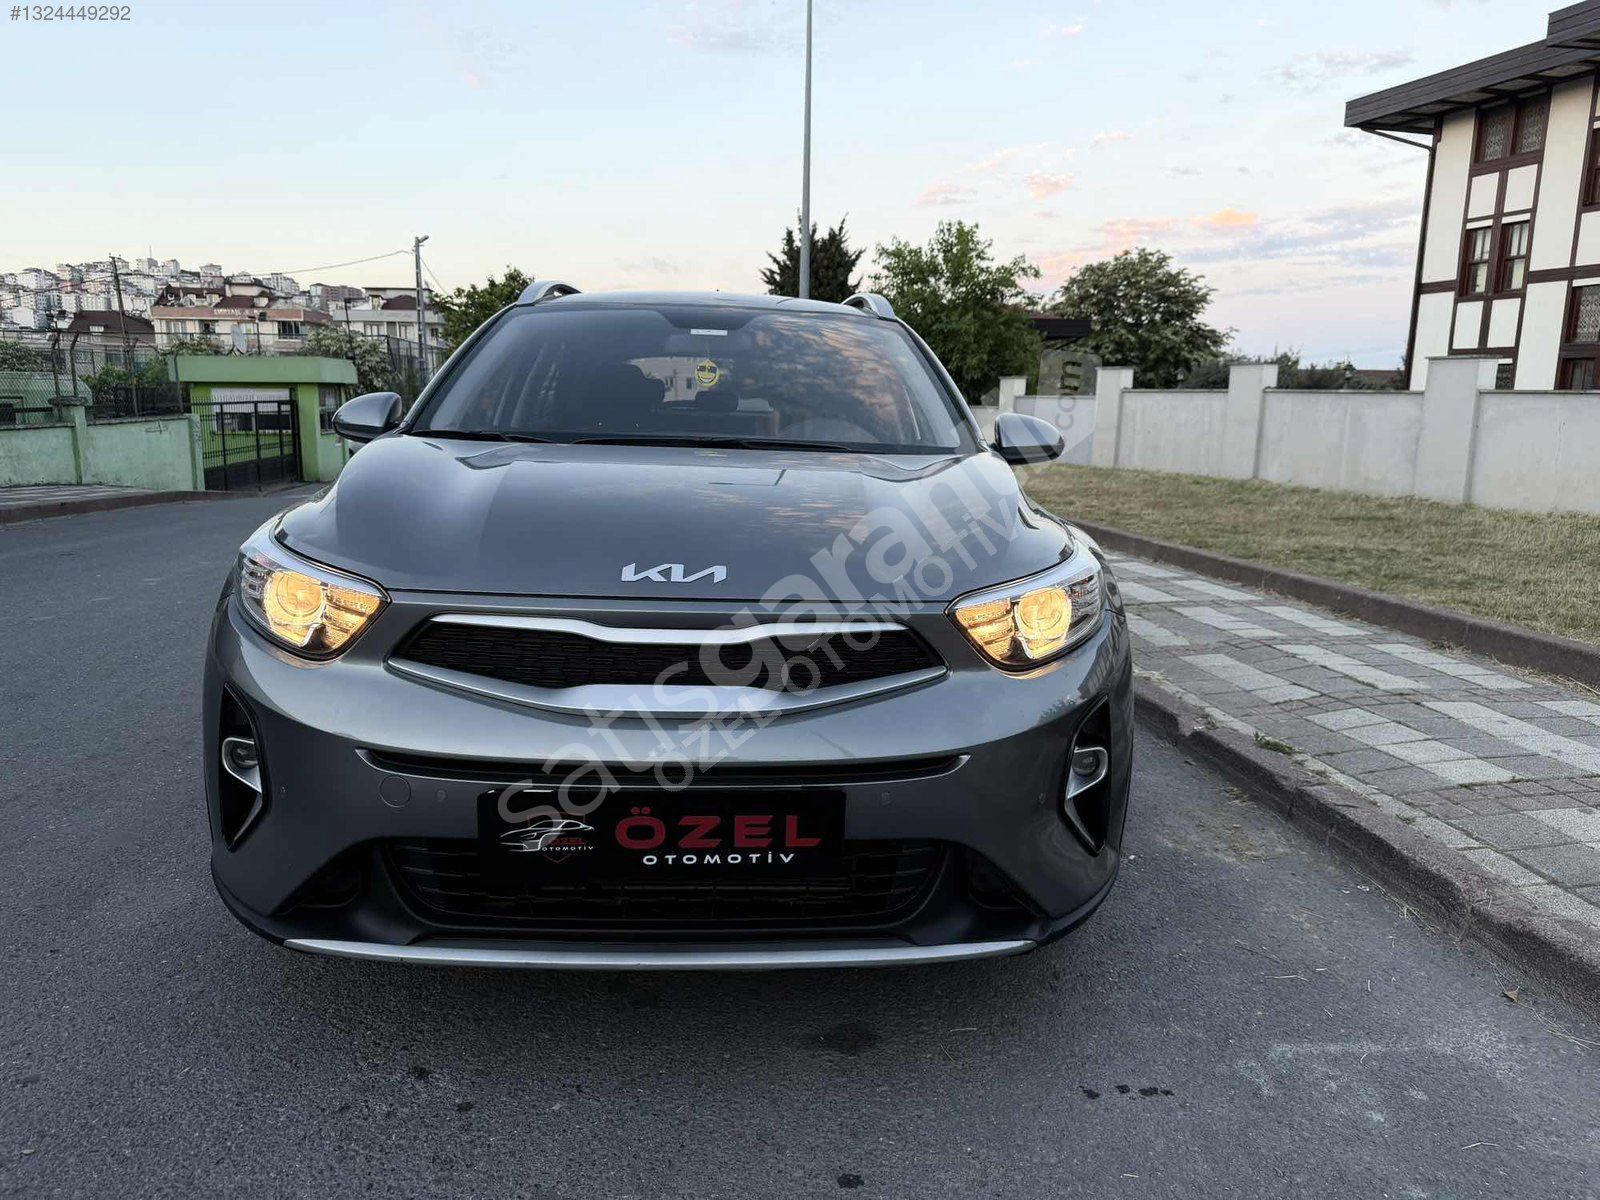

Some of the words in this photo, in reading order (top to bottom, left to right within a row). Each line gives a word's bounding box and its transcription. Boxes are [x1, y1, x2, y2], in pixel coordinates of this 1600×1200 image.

[621, 562, 727, 583] KIA
[615, 807, 822, 850] ÖZEL
[642, 851, 795, 866] OTOMOTİV
